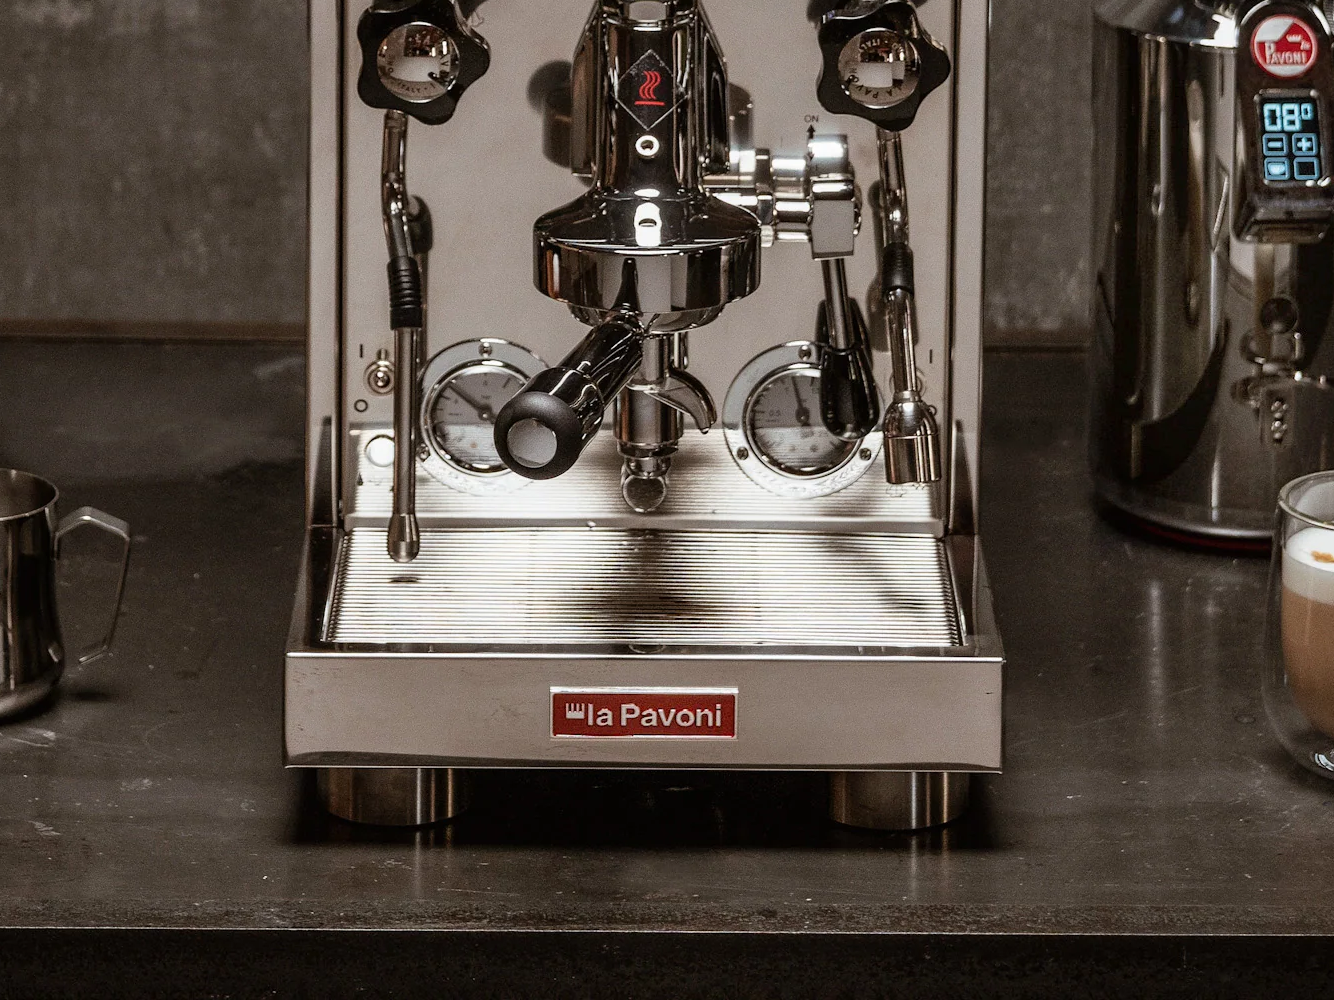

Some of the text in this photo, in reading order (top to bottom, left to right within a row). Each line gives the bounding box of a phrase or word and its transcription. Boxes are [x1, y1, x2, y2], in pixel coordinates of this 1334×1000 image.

[1264, 41, 1307, 65] PAVONI
[804, 114, 819, 123] ON
[587, 703, 722, 727] la Pavoni
